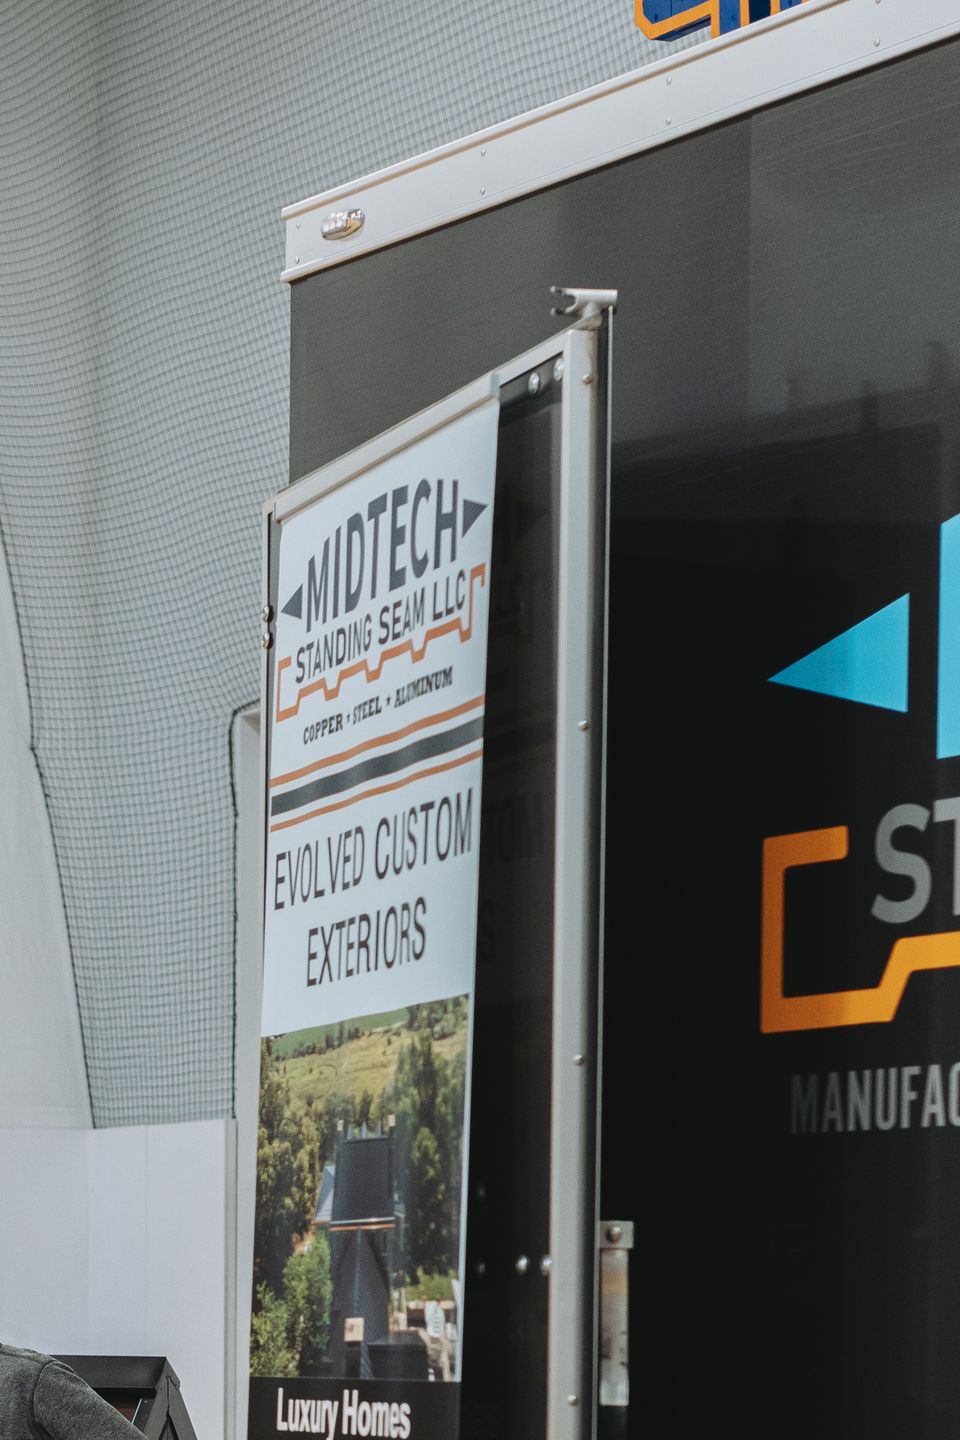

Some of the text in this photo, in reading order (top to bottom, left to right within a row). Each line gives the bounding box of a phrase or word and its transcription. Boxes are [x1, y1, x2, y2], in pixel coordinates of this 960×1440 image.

[306, 479, 458, 633] MIDTECH
[295, 569, 466, 683] STANDING SEAM LLC
[303, 665, 453, 745] COPPER STEEL ALUMINUM
[274, 787, 473, 910] EVOLVED CUSTOM
[306, 896, 427, 987] EXTERIORS
[342, 1389, 411, 1440] Homes
